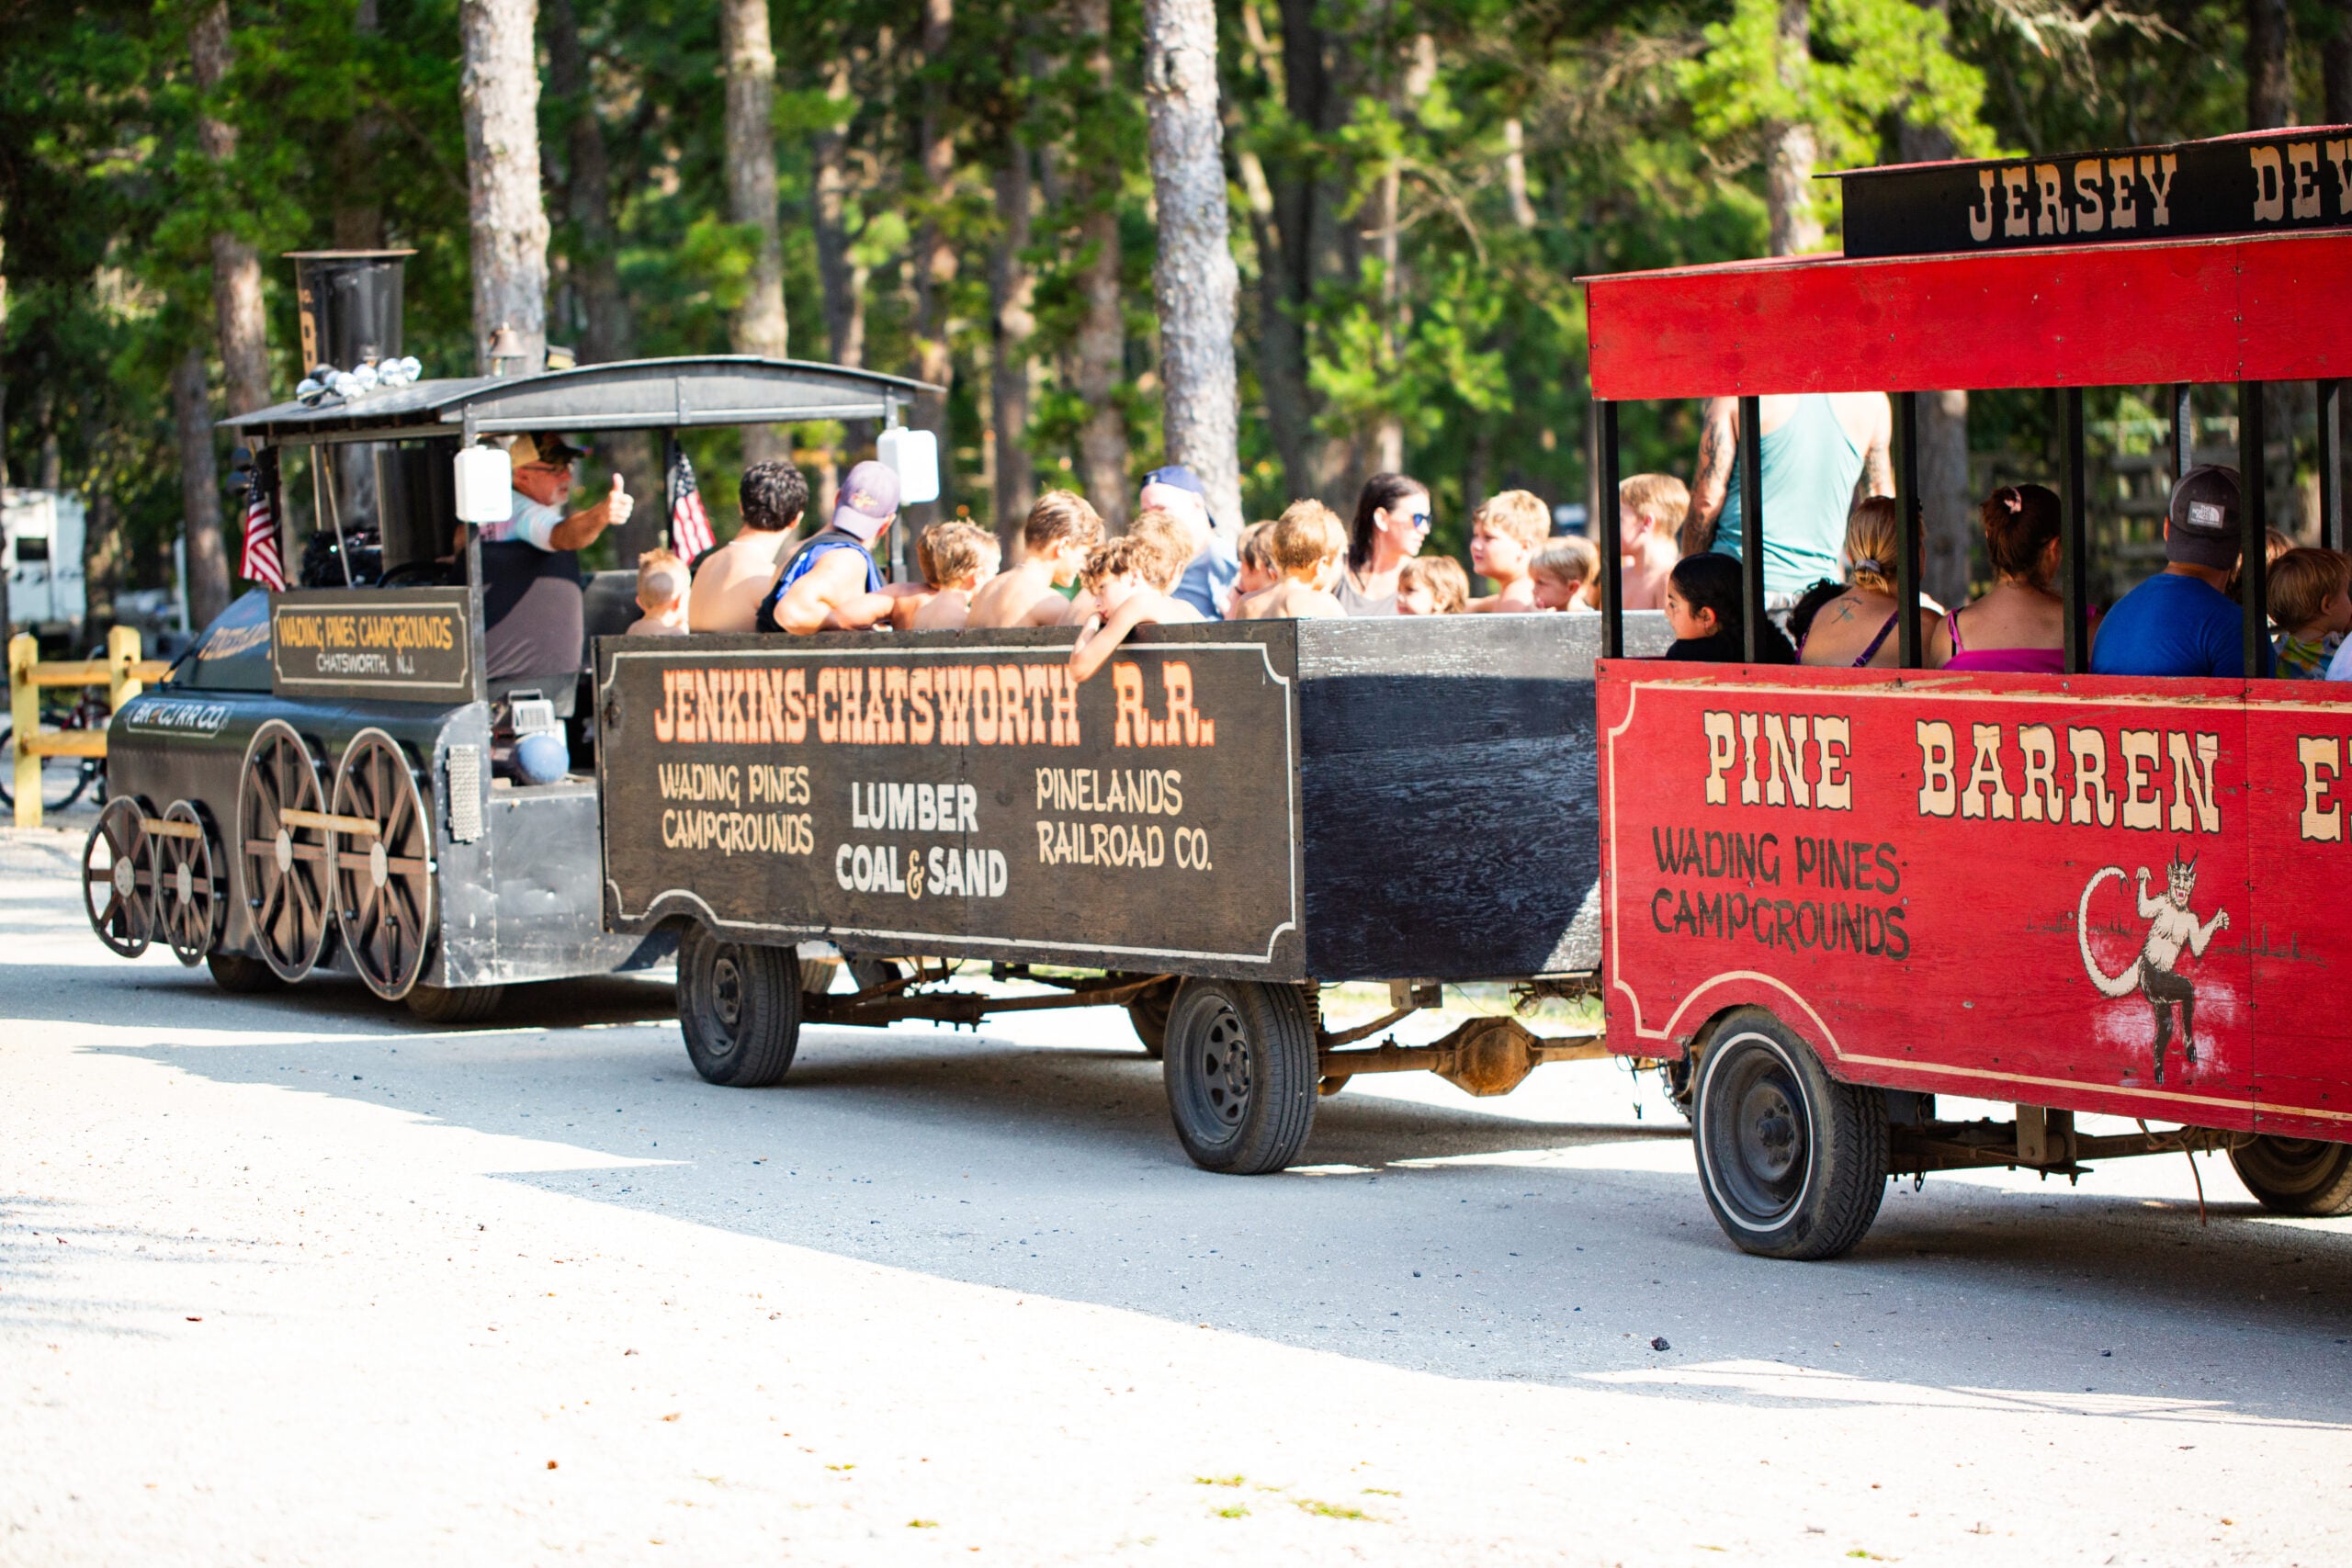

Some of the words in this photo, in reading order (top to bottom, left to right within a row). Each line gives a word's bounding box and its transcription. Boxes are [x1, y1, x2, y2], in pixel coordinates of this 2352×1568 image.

[1969, 152, 2177, 243] JERSEY
[278, 615, 324, 652] WADING
[325, 615, 356, 648] PINES
[358, 615, 453, 654] CAMPGROUNDS
[316, 653, 390, 674] CHATSWORTH,
[396, 654, 415, 673] N.J.
[1112, 660, 1216, 748] R.R.
[659, 764, 740, 809] WADING
[749, 764, 810, 806] PINES
[1035, 767, 1182, 816] PINELANDS
[1703, 710, 1853, 811] PINE
[1916, 718, 2222, 834] BARREN
[662, 808, 814, 857] CAMPGROUNDS
[852, 782, 978, 832] LUMBER
[1035, 820, 1165, 868] RAILROAD
[1174, 827, 1213, 871] CO.
[1652, 826, 1781, 886] WADING
[1795, 835, 1901, 895] PINES
[835, 843, 906, 893] COAL
[906, 850, 925, 900] &
[926, 846, 1008, 897] SAND
[1651, 887, 1910, 961] CAMPGROUNDS
